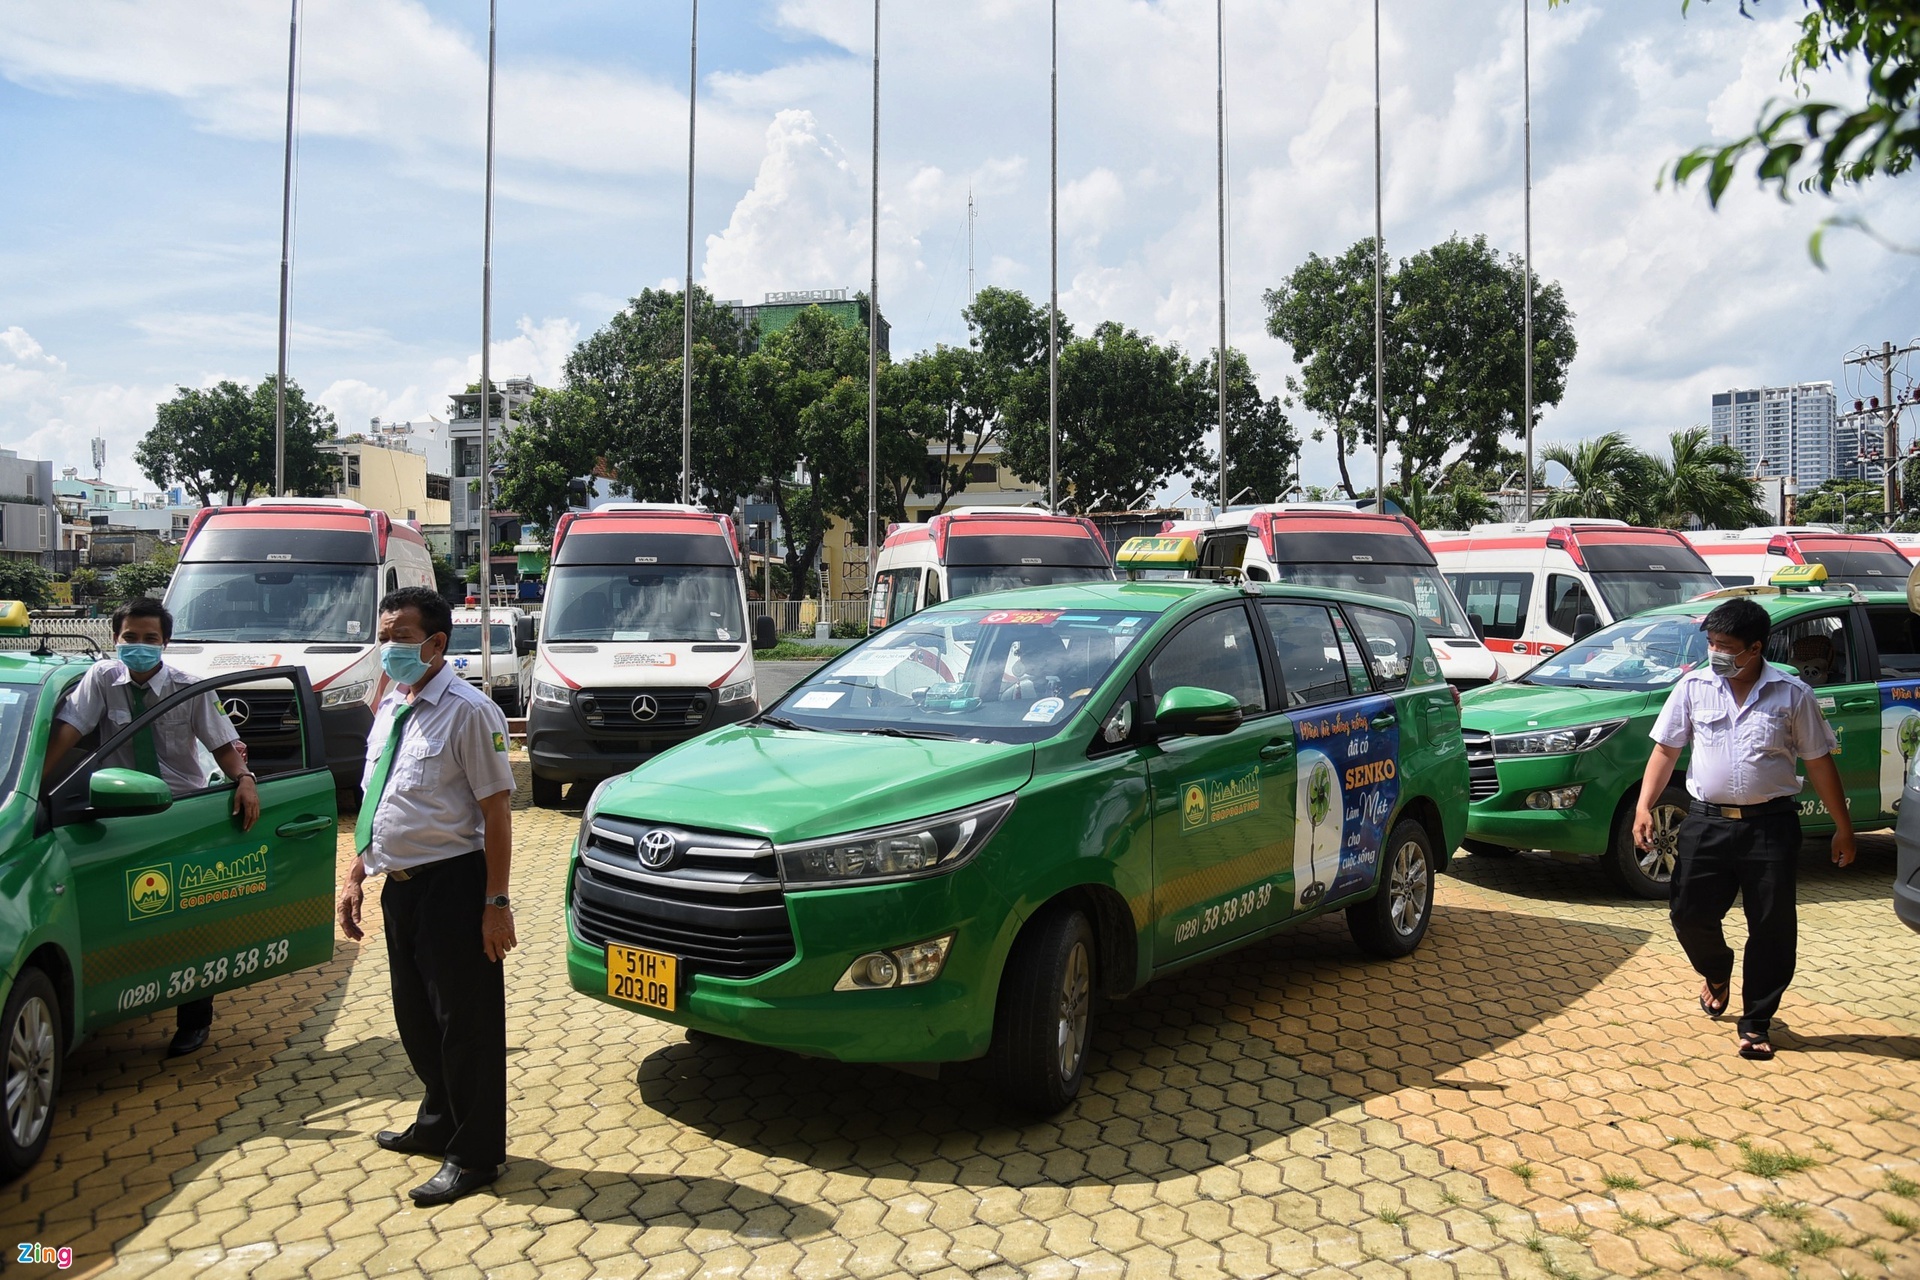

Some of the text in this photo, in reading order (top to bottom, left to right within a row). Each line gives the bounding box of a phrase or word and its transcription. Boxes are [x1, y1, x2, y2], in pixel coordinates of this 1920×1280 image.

[1299, 720, 1319, 740] Mùa
[1347, 735, 1369, 757] đã có
[1345, 758, 1396, 790] SENKO
[1210, 800, 1260, 822] CORPORATION
[1346, 790, 1389, 826] Làm Mát
[1347, 831, 1361, 847] cho
[1342, 846, 1376, 870] cuộc sống
[179, 881, 267, 910] CORPORATION
[1174, 882, 1272, 946] (028) 38 38 38 38
[117, 939, 290, 1013] (028) 38 38 38 38
[626, 950, 657, 978] 51H
[614, 973, 668, 1007] 203.08
